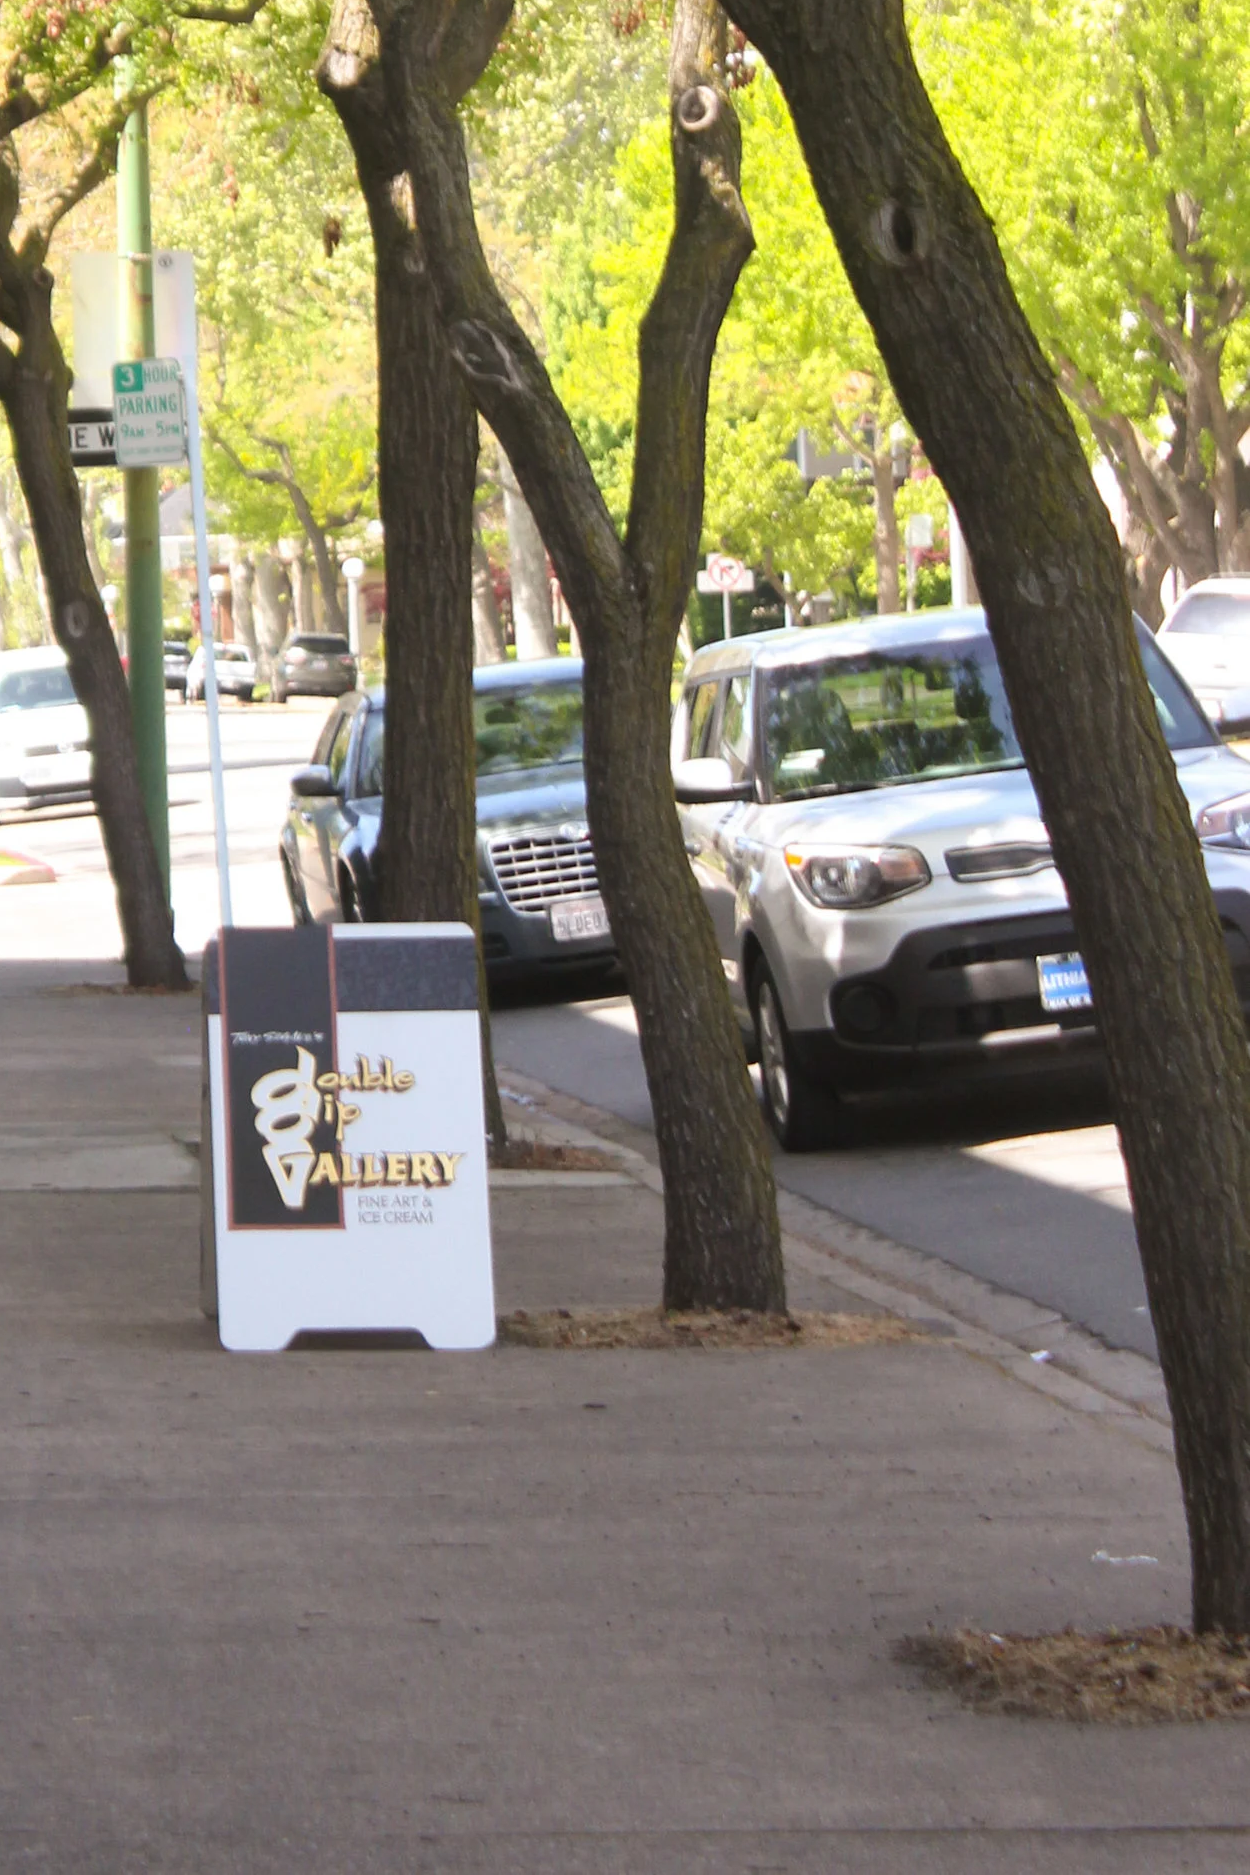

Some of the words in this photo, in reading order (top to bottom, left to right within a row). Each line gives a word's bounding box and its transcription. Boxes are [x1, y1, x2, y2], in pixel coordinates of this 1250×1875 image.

[121, 365, 136, 388] 3
[143, 365, 178, 384] HOUR
[119, 393, 178, 415] PARKING
[357, 1194, 388, 1208] FINE
[391, 1194, 419, 1208] ART
[358, 1211, 381, 1223] ICE
[383, 1210, 434, 1224] CREAM
